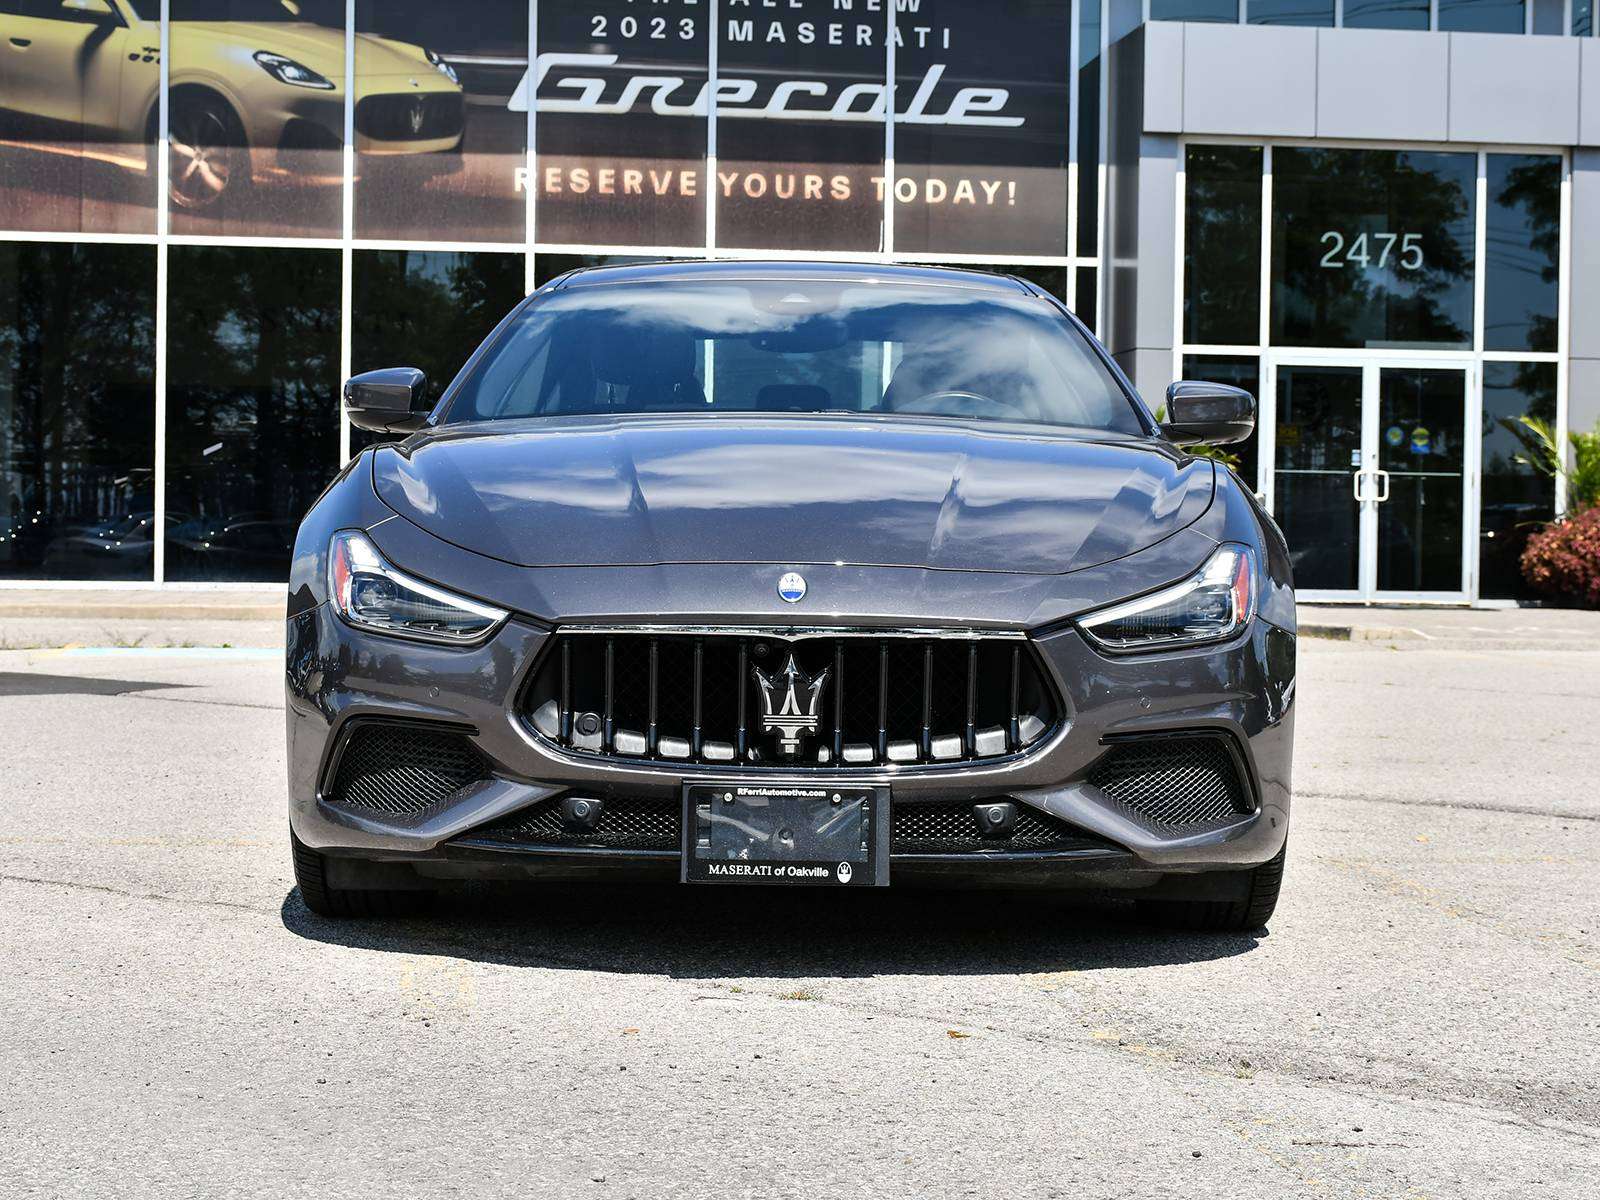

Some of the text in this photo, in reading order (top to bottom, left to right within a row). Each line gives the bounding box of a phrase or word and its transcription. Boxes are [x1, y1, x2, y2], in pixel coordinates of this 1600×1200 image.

[591, 15, 950, 49] 2023 MASERATI
[507, 53, 1026, 127] Grecale
[514, 167, 1017, 206] RESERVE YOURS TODAY!
[1320, 231, 1424, 270] 2475
[737, 787, 827, 797] RFerriAutomotive.com
[708, 864, 829, 877] MASERATI of Oakville
